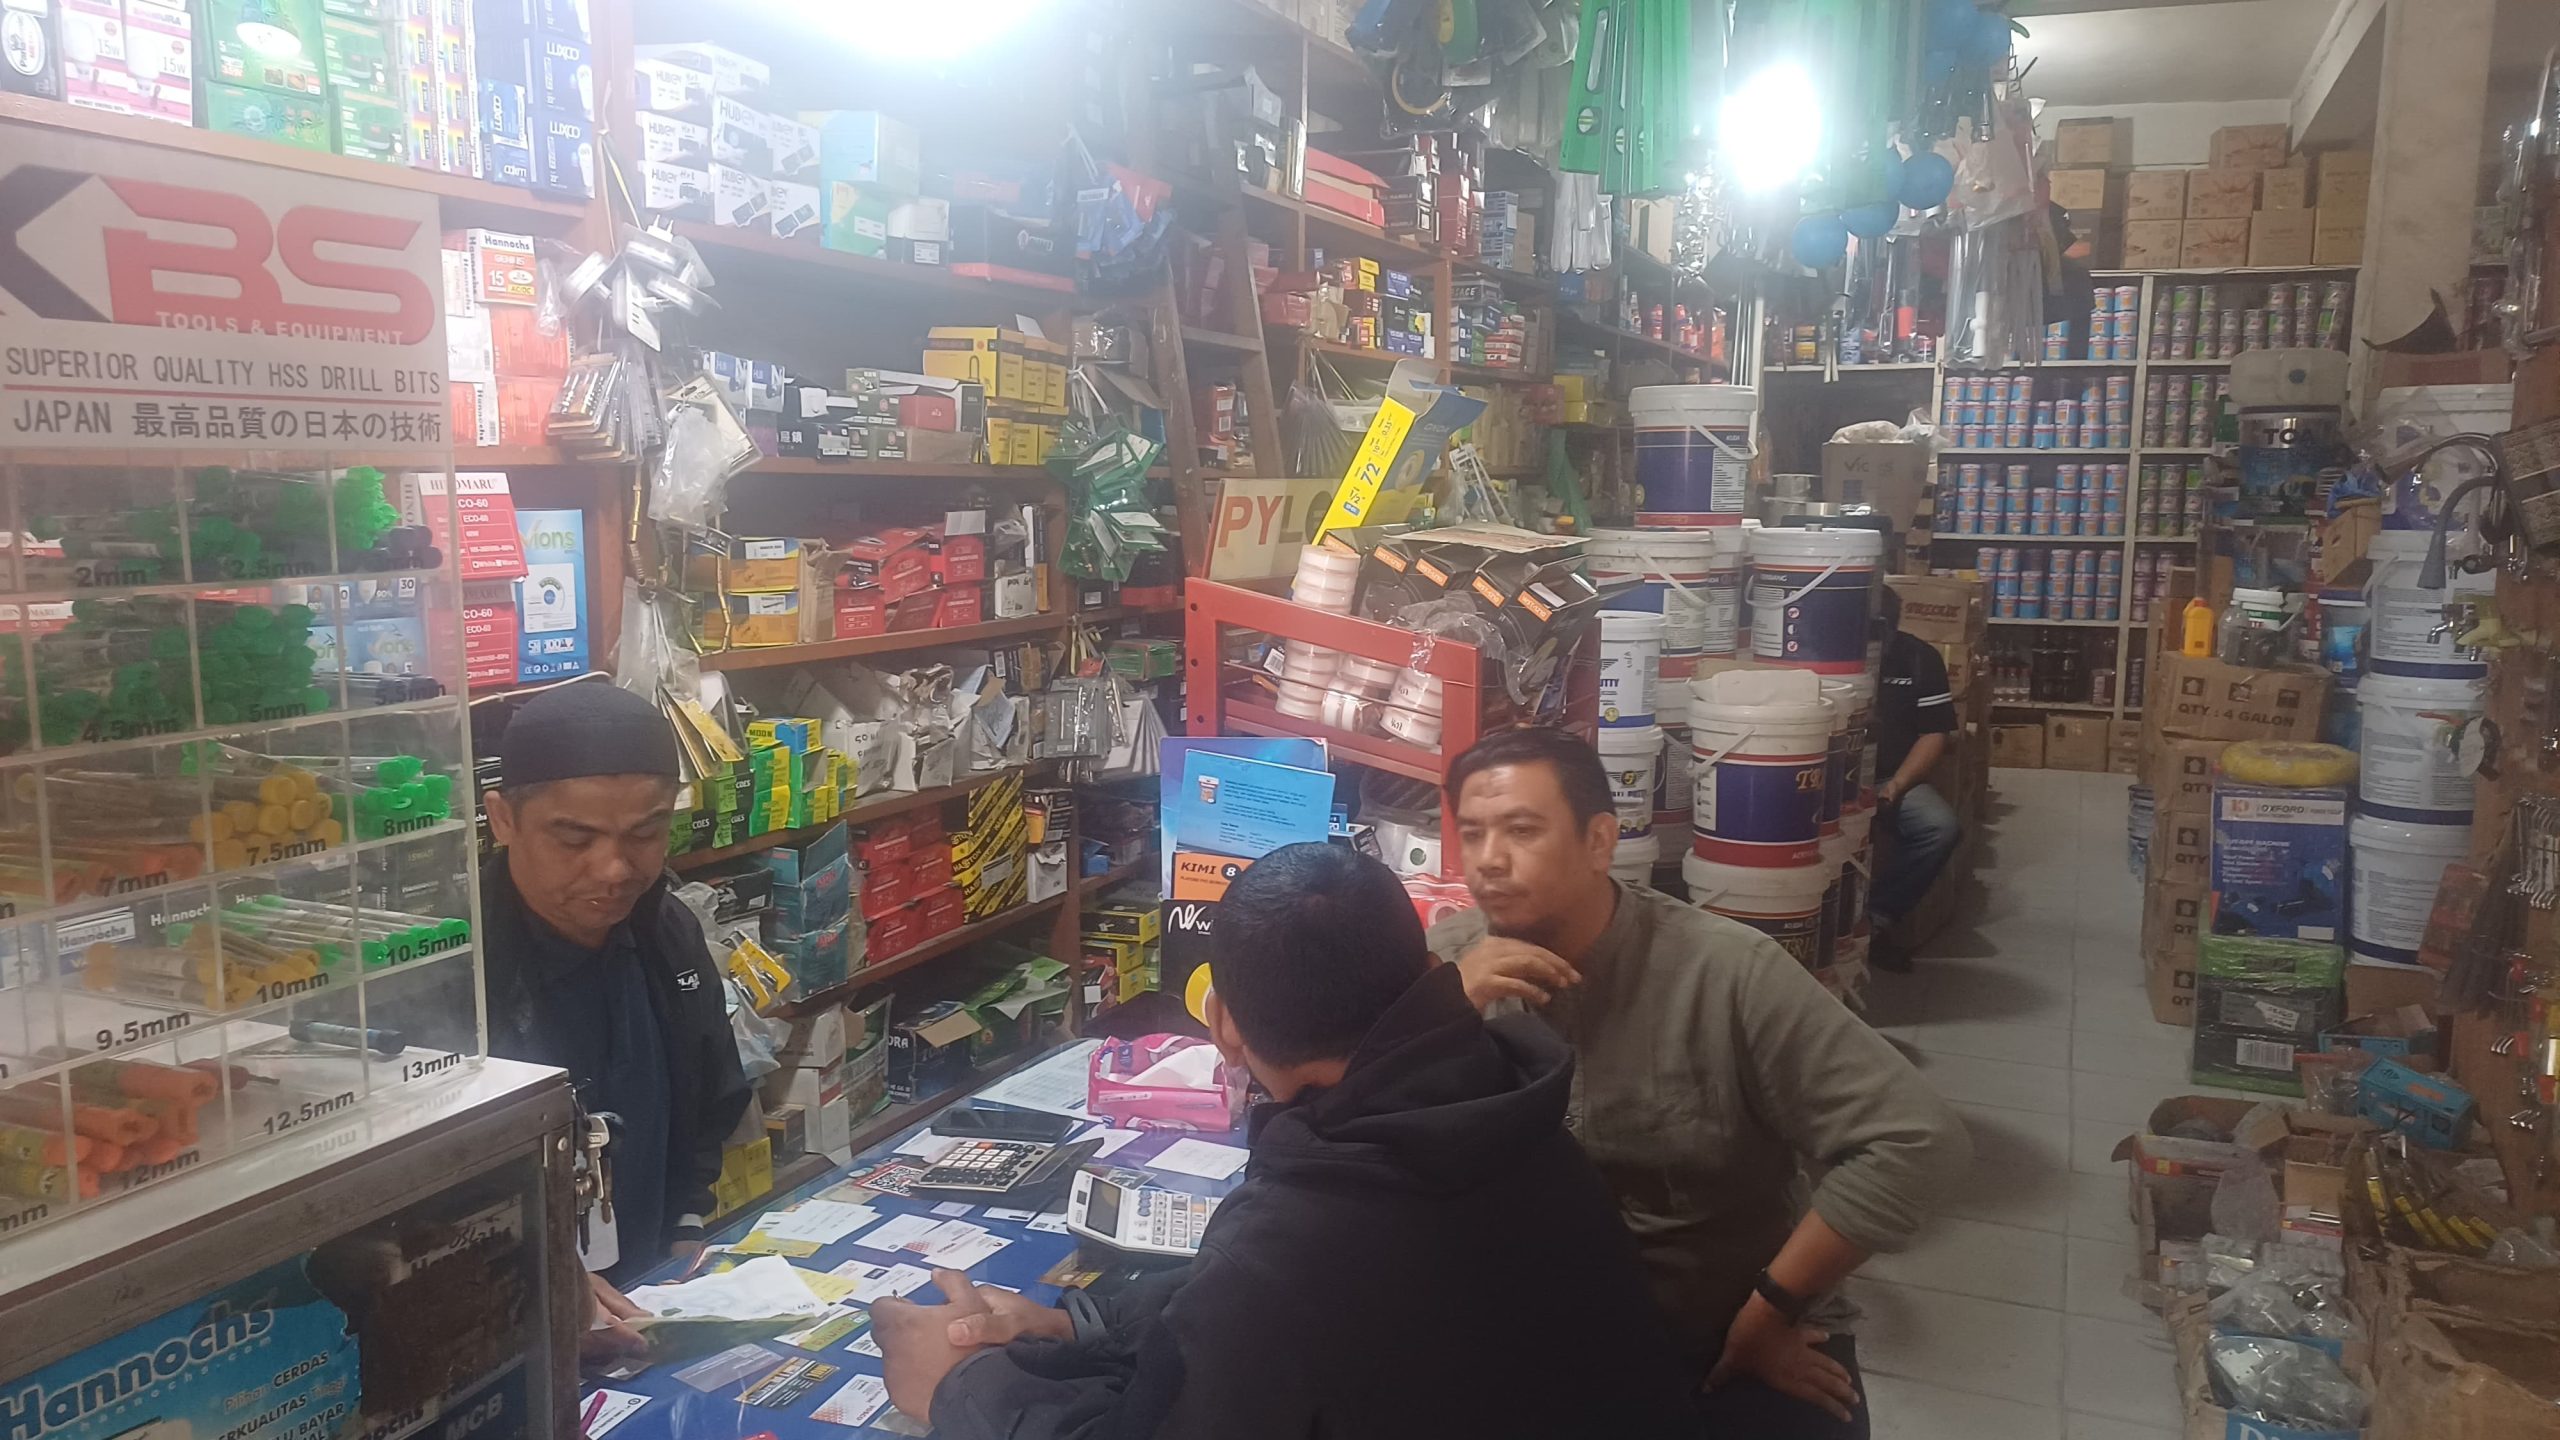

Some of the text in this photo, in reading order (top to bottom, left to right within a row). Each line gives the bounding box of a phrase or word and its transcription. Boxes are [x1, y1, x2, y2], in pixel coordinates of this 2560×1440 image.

[483, 235, 531, 251] Hannochs
[488, 270, 505, 286] 15
[155, 310, 403, 346] TOOLS & EQUIPMENT
[5, 346, 441, 395] SUPERIOR QUALITY HSS DRILL BITS
[13, 399, 442, 444] JAPAN 最高品質の日本の技術
[430, 478, 497, 491] HIOMARU
[457, 498, 489, 508] CO-60
[1217, 491, 1332, 549] PYLO
[75, 566, 147, 588] 2mm
[400, 579, 415, 590] 30
[463, 608, 493, 619] CO-60
[250, 703, 307, 722] 5mm
[2178, 702, 2210, 717] QTY
[2223, 709, 2234, 720] 4
[2238, 710, 2296, 728] GALON
[2181, 781, 2213, 794] QTY
[2261, 804, 2305, 815] OXFORD
[382, 813, 434, 837] 8mm
[246, 837, 327, 866] 7.5mm
[953, 849, 982, 872] HASTON
[2174, 852, 2210, 865] QTY
[1180, 861, 1237, 878] KIMI 8
[97, 871, 168, 898] 7mm
[150, 903, 212, 927] Hannoch
[58, 925, 127, 949] Hannochs
[2172, 923, 2198, 935] QT
[385, 930, 468, 967] 10.5mm
[256, 971, 330, 1003] 10mm
[2171, 994, 2194, 1007] QT
[96, 1011, 191, 1051] 9.5mm
[402, 1052, 461, 1083] 13mm
[263, 1091, 355, 1134] 12.5mm
[121, 1149, 199, 1190] 12mm
[0, 1300, 275, 1440] Hannochs
[272, 1351, 329, 1388] CERDAS
[217, 1393, 307, 1440] ERKUALITAS
[298, 1402, 345, 1436] BAYAR
